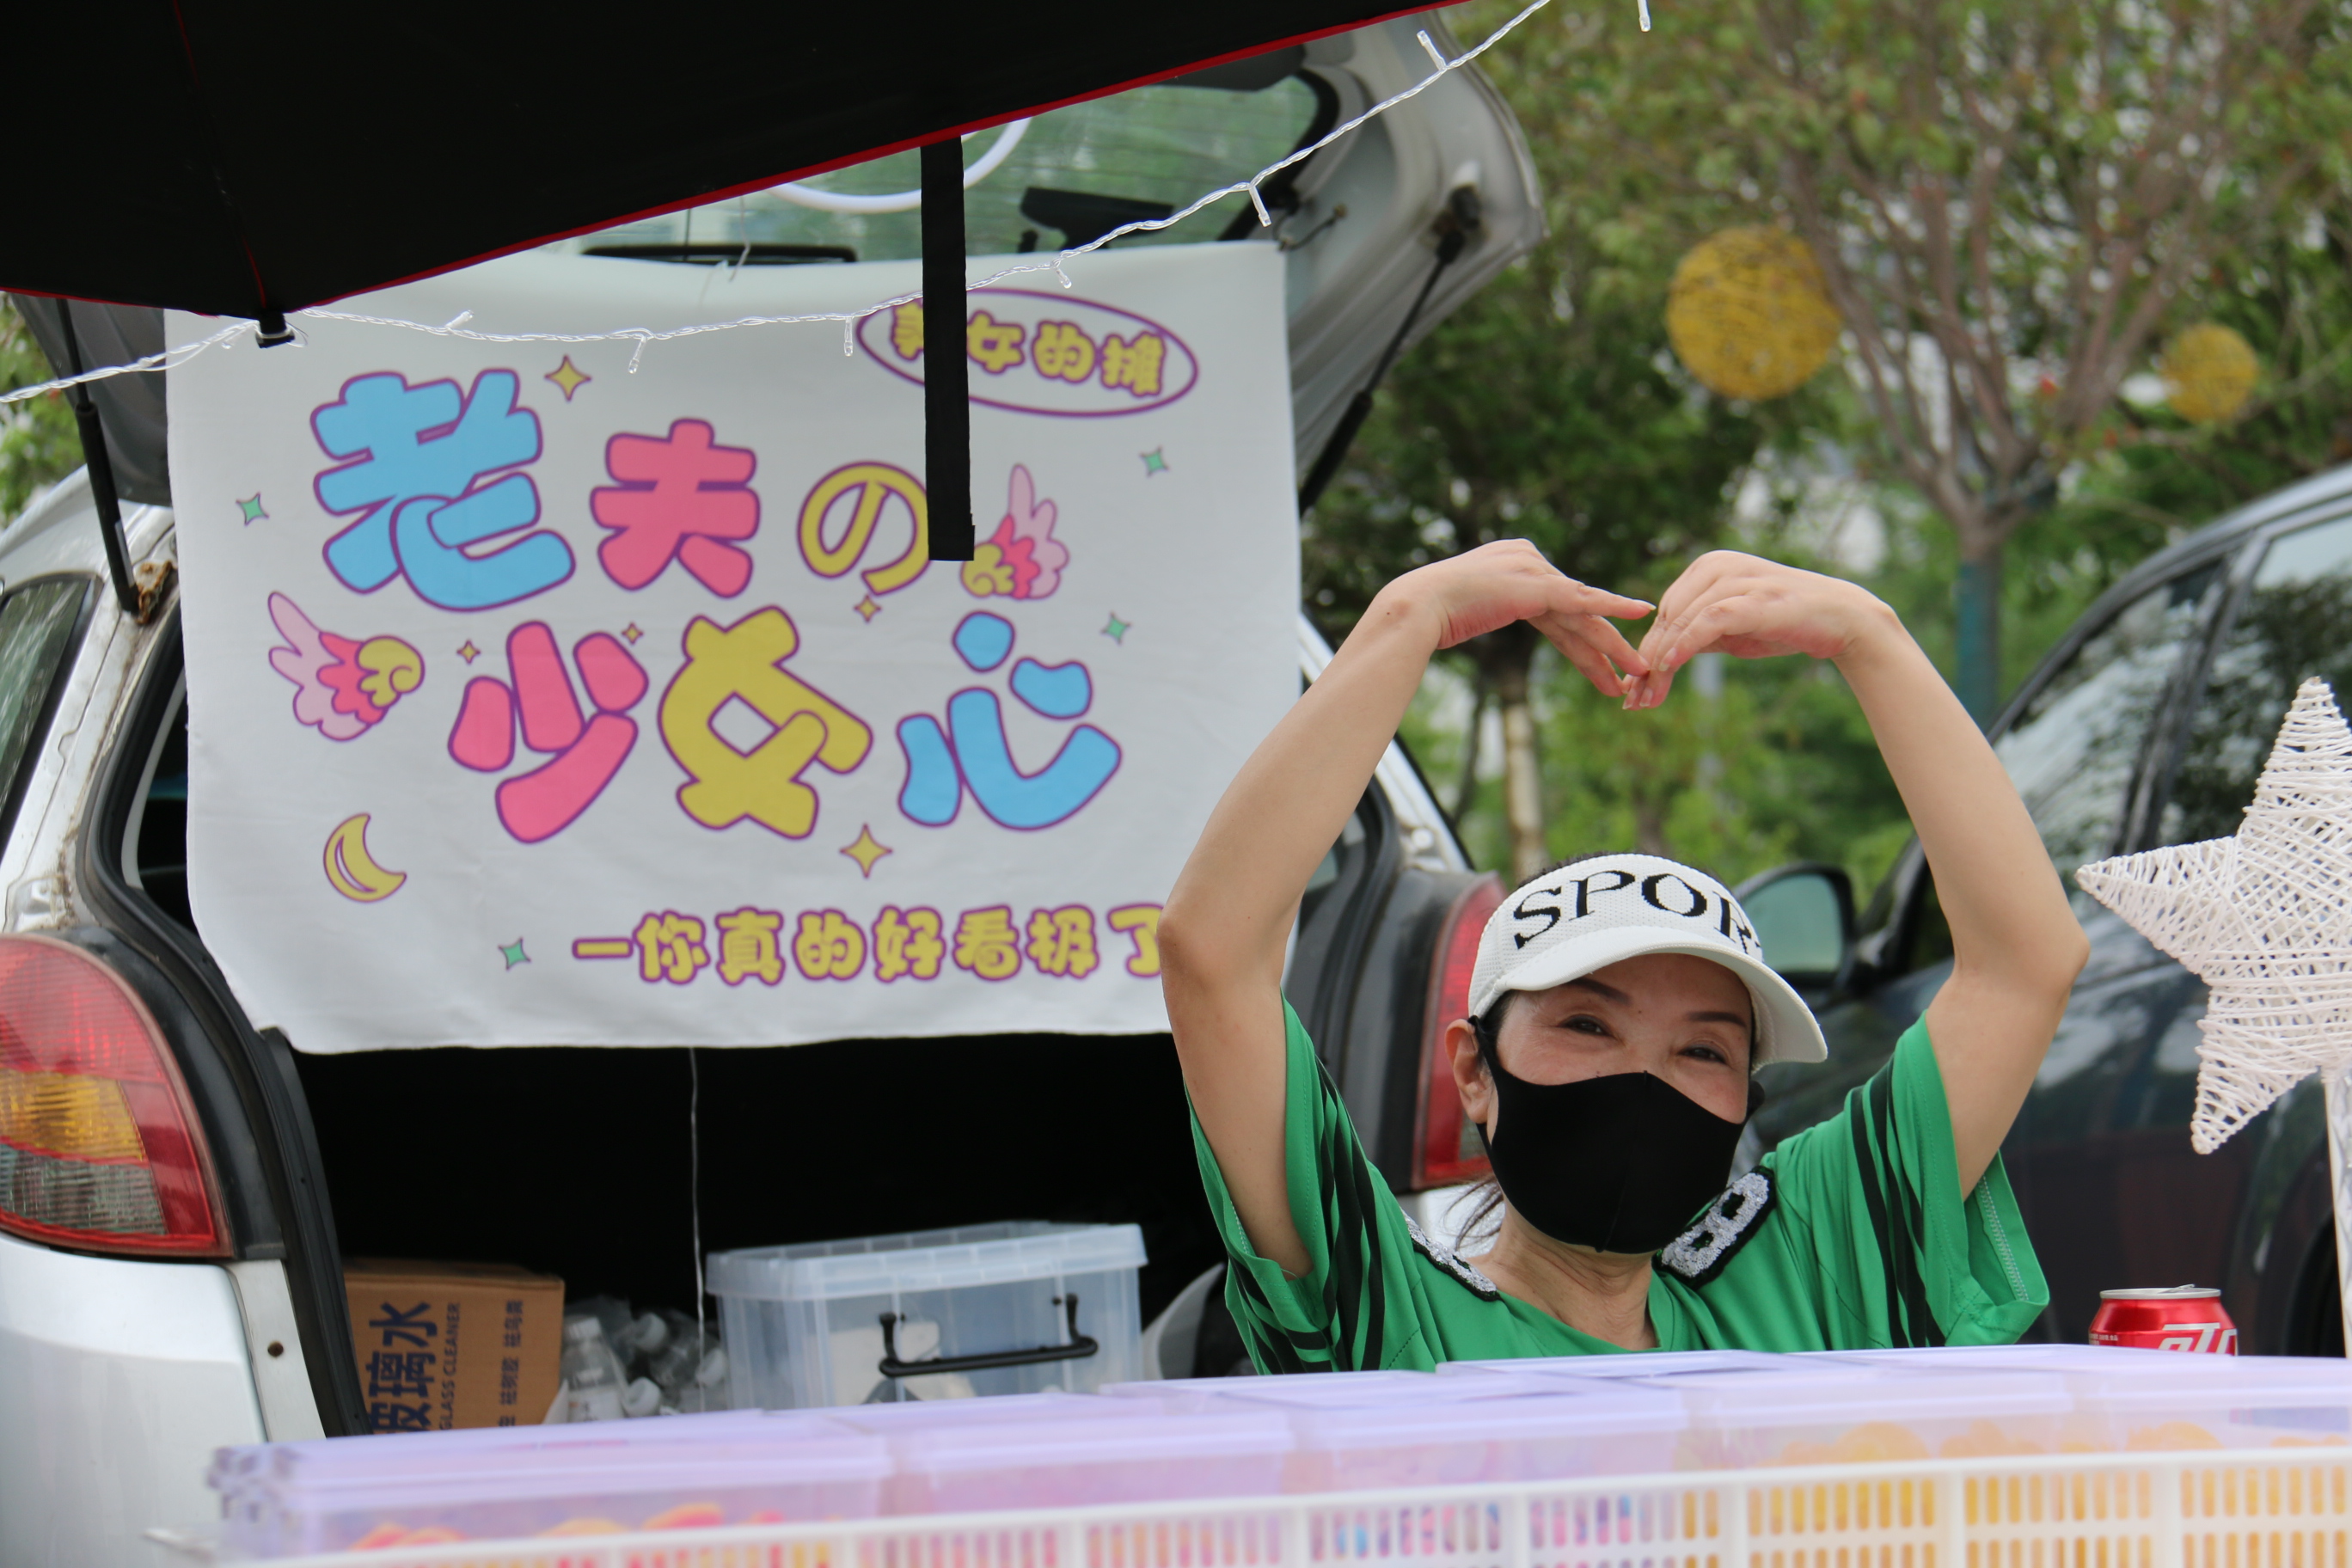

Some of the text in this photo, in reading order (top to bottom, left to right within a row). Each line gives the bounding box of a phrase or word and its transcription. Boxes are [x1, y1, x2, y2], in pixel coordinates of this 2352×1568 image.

[309, 369, 930, 611] 老夫の
[448, 605, 1121, 842] 少女心
[1513, 870, 1761, 954] SPOR
[439, 1302, 461, 1430] GLASS CLEANER
